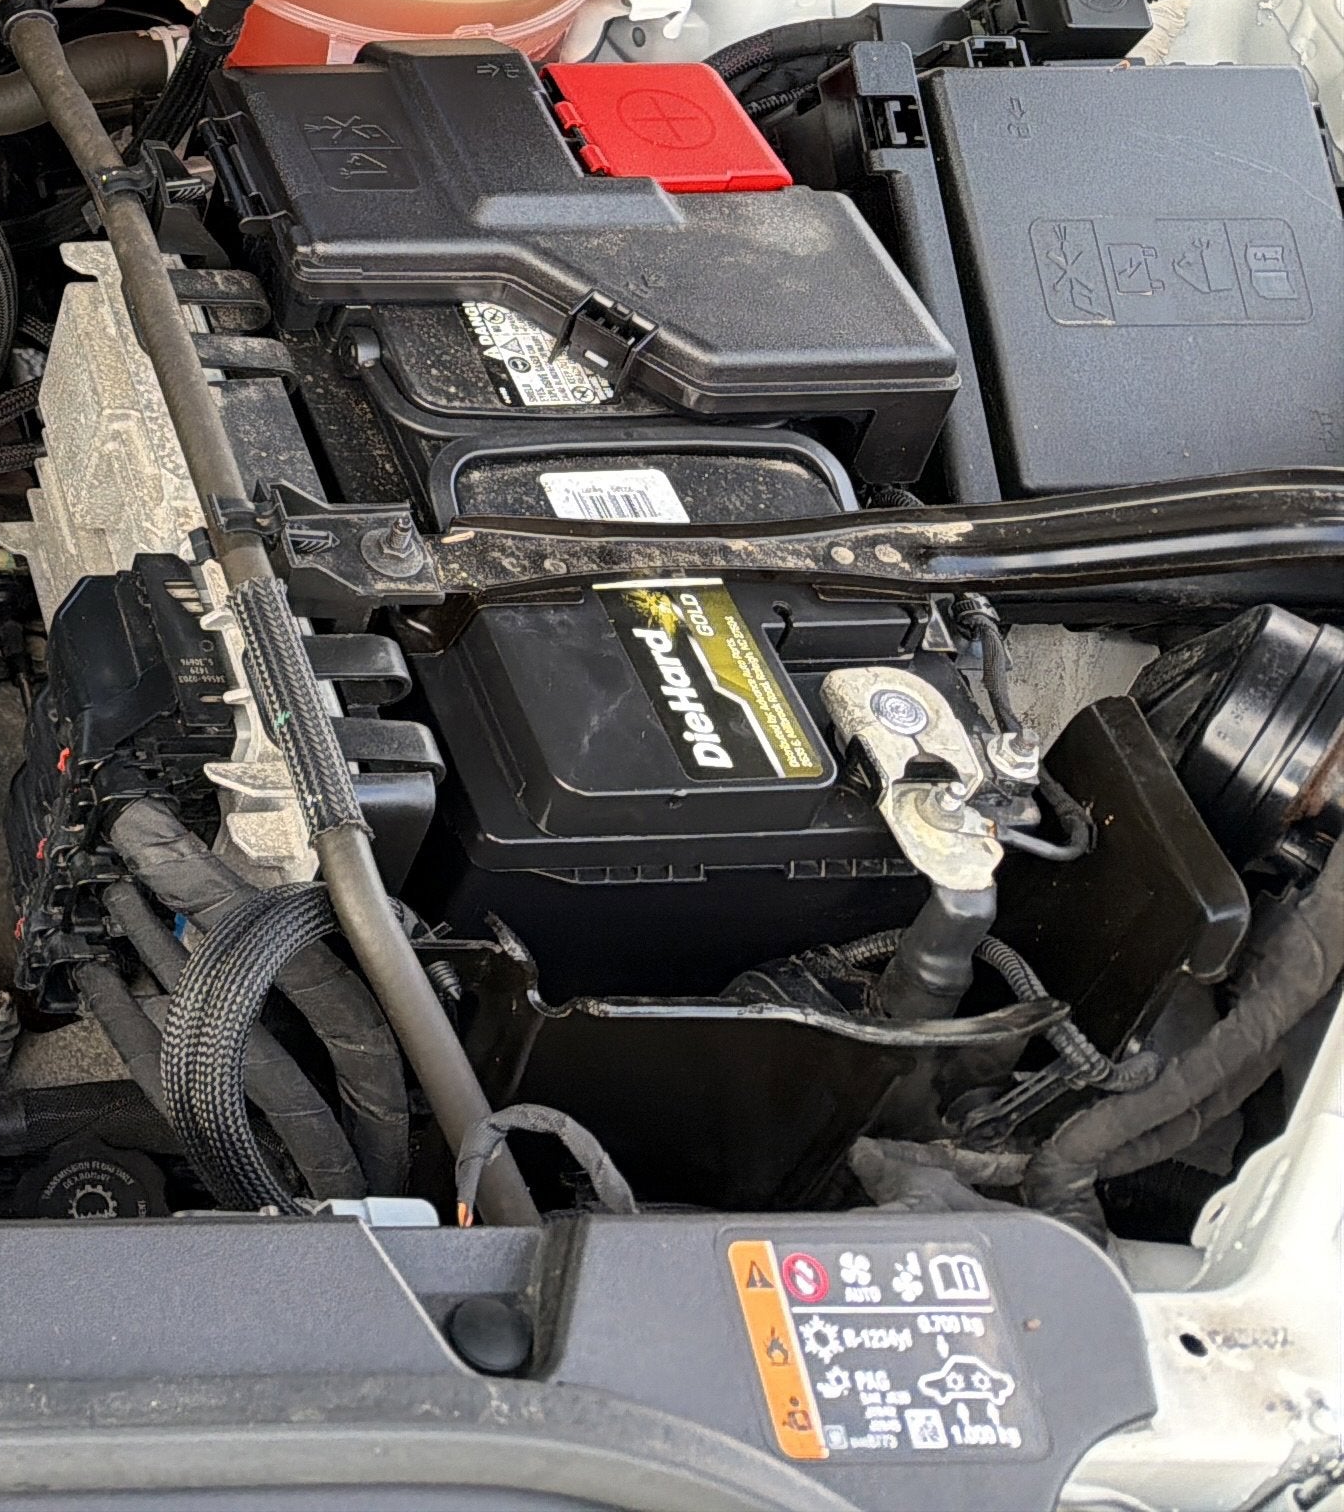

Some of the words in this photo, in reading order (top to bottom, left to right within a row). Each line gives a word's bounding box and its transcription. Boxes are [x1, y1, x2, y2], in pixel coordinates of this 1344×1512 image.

[679, 593, 714, 637] GOLD
[632, 627, 734, 768] DieHard
[845, 1286, 881, 1303] AUTO
[961, 1315, 985, 1337] kg
[855, 1370, 891, 1391] PAG
